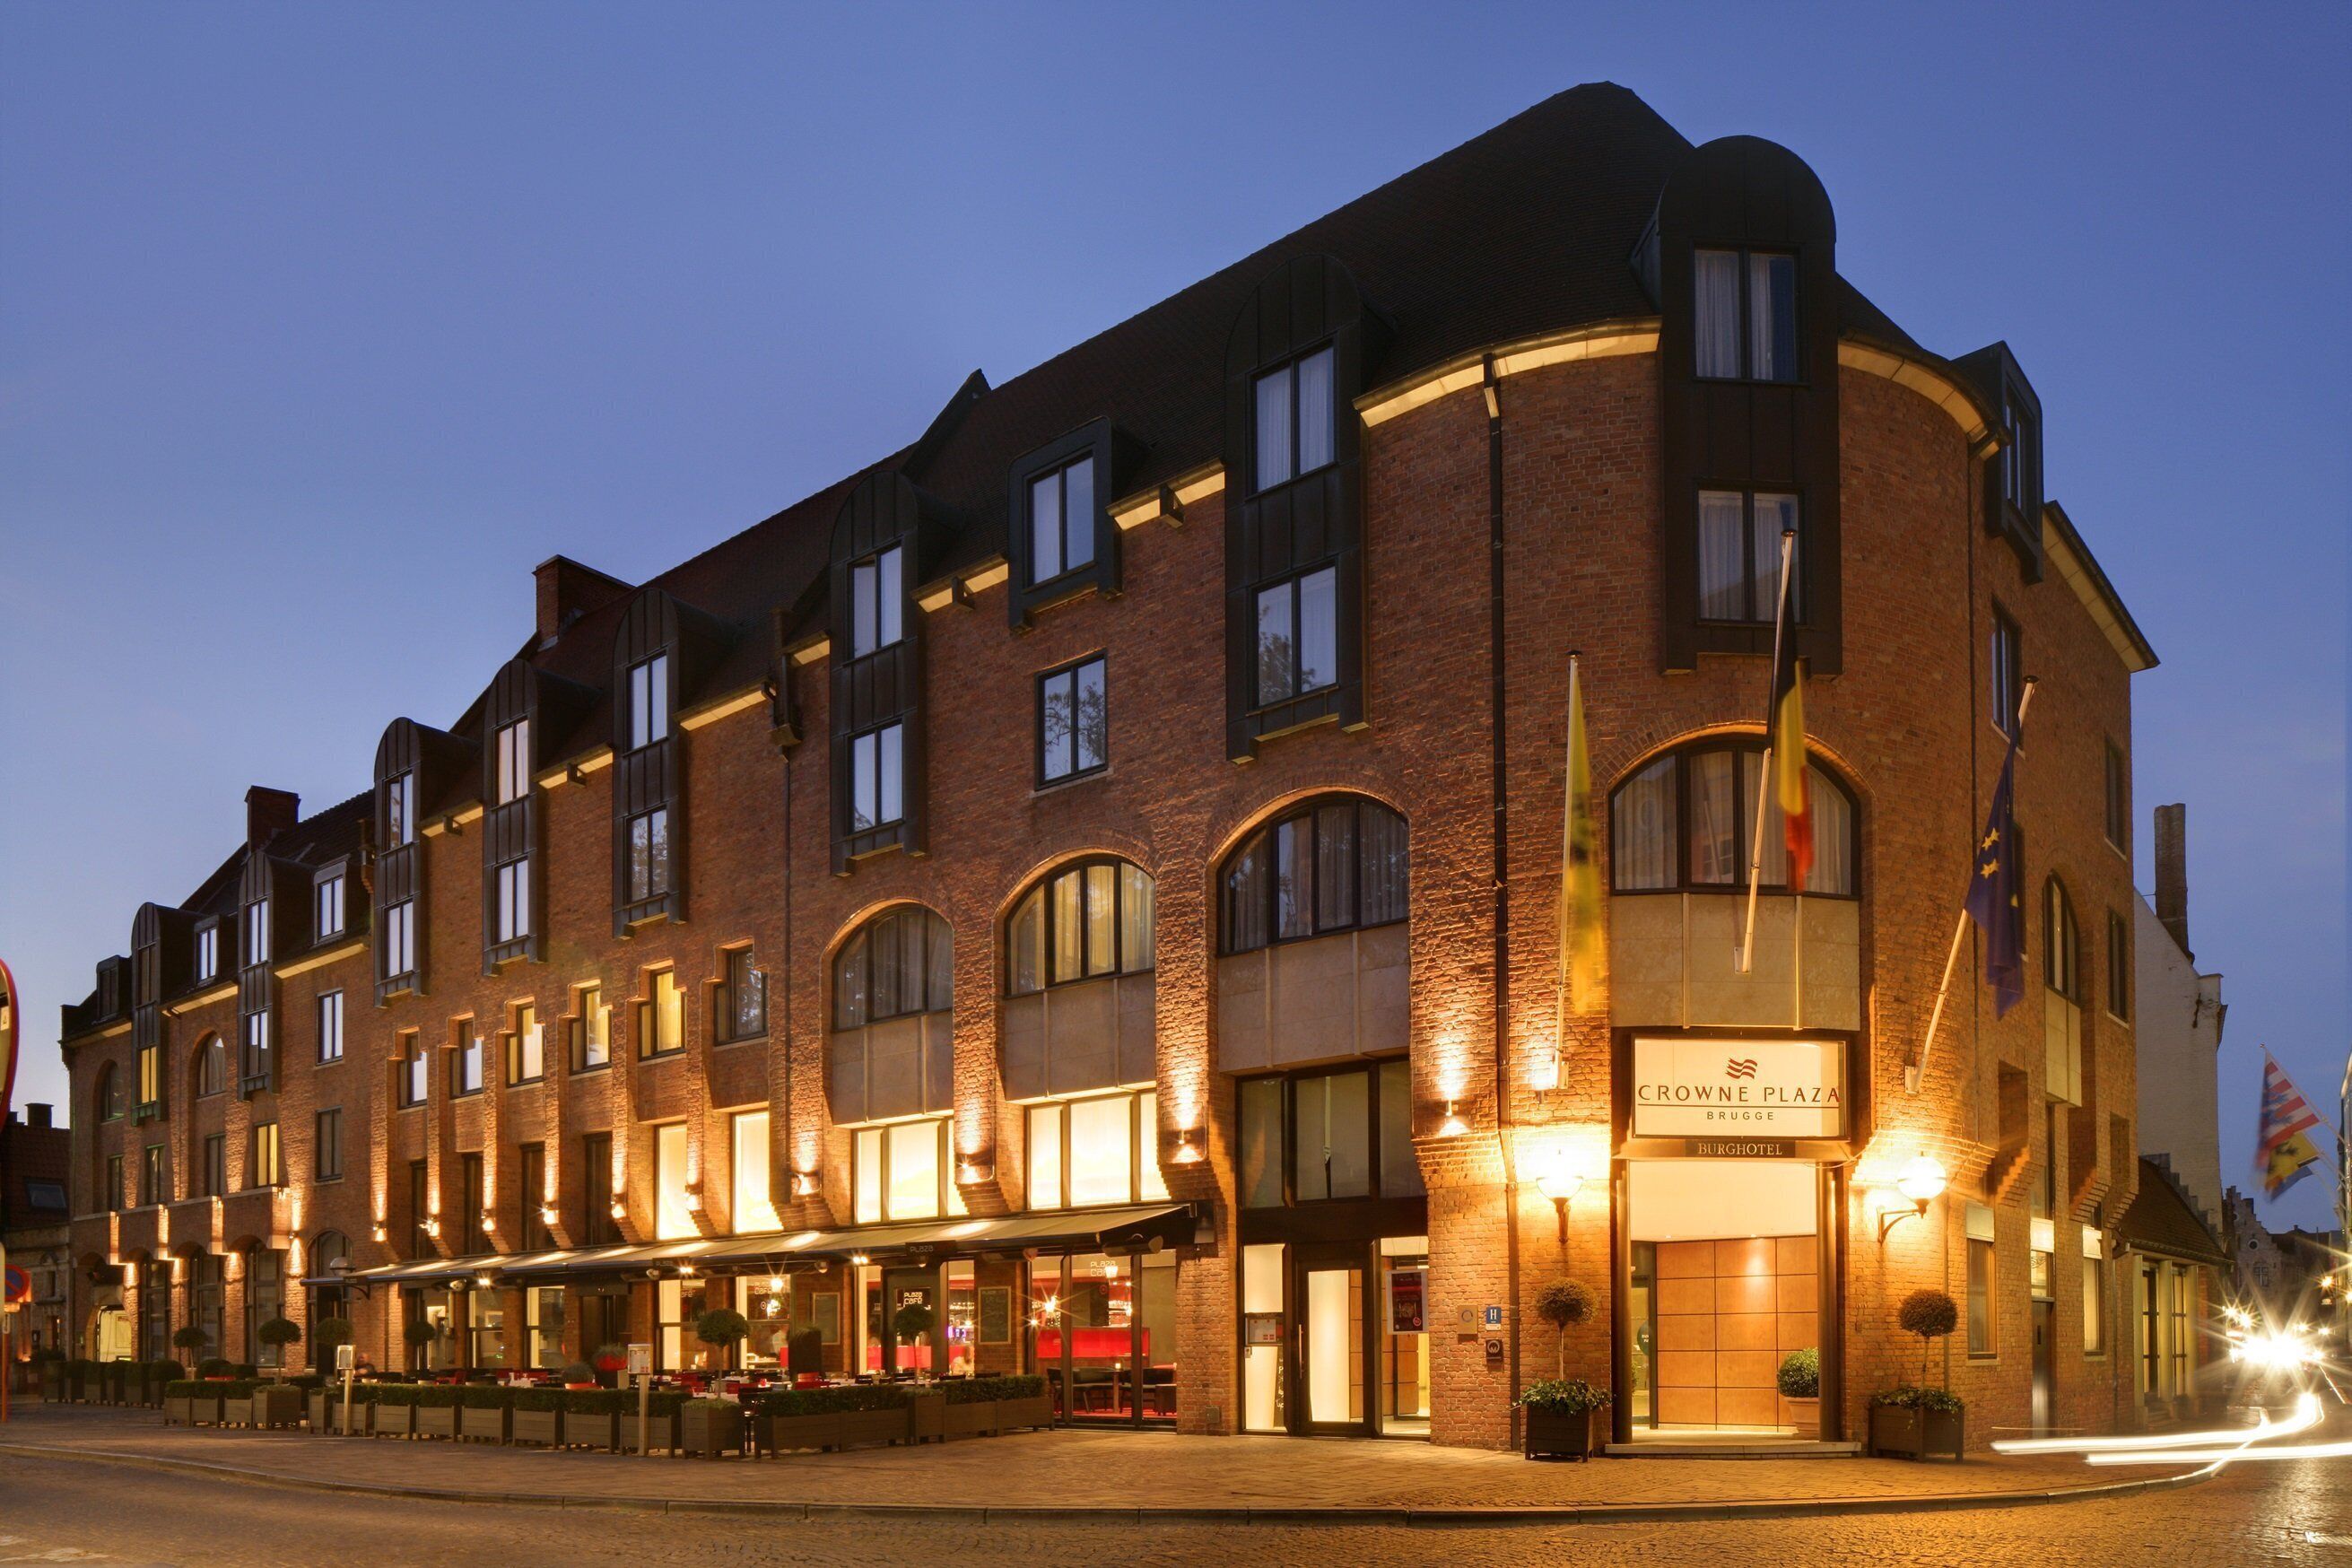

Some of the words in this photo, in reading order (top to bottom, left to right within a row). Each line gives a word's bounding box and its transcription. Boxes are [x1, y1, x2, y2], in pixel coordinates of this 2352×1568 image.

[1638, 1085, 1749, 1102] CROWNE
[1764, 1086, 1841, 1102] PLAZA
[1706, 1111, 1774, 1120] BRUGGE
[1697, 1143, 1783, 1156] BURGHOTEL
[1490, 1309, 1497, 1320] H
